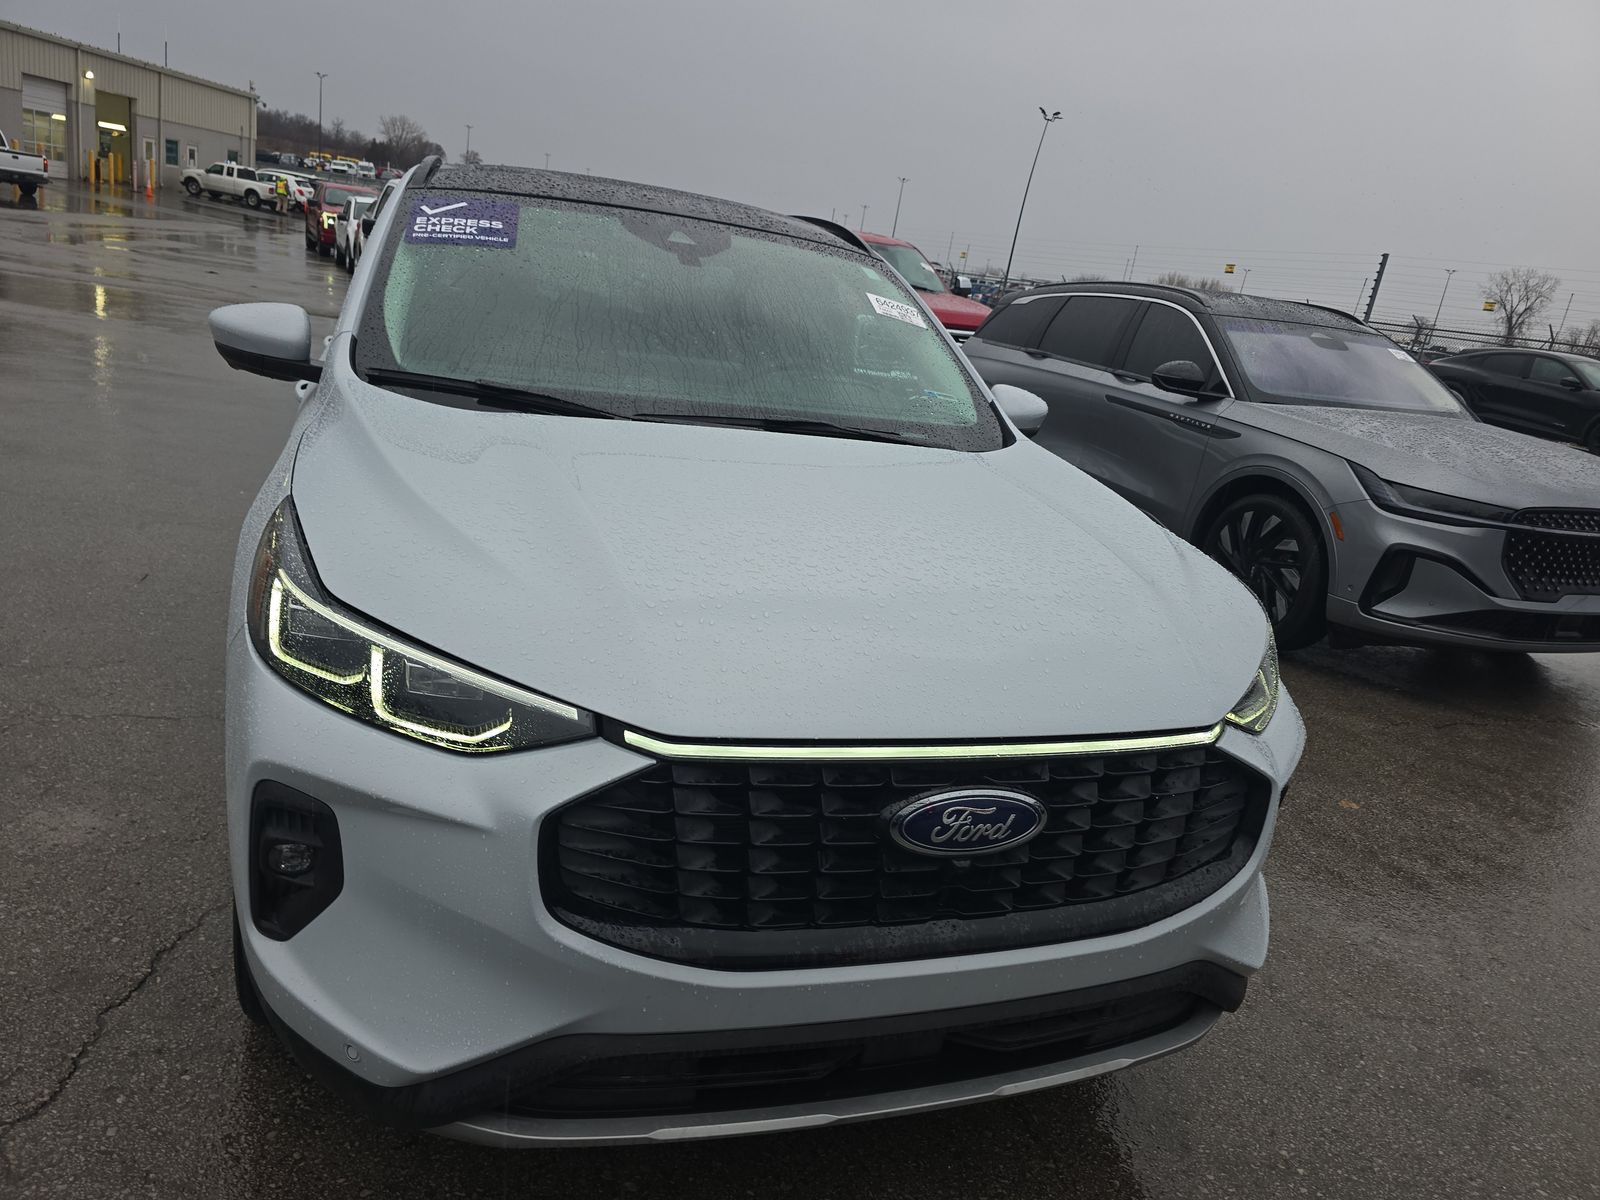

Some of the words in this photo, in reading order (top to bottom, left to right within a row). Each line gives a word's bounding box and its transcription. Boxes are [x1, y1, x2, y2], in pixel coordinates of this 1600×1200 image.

[413, 224, 478, 234] CHECK
[416, 216, 503, 229] EXPRESS
[930, 806, 1016, 843] Ford
